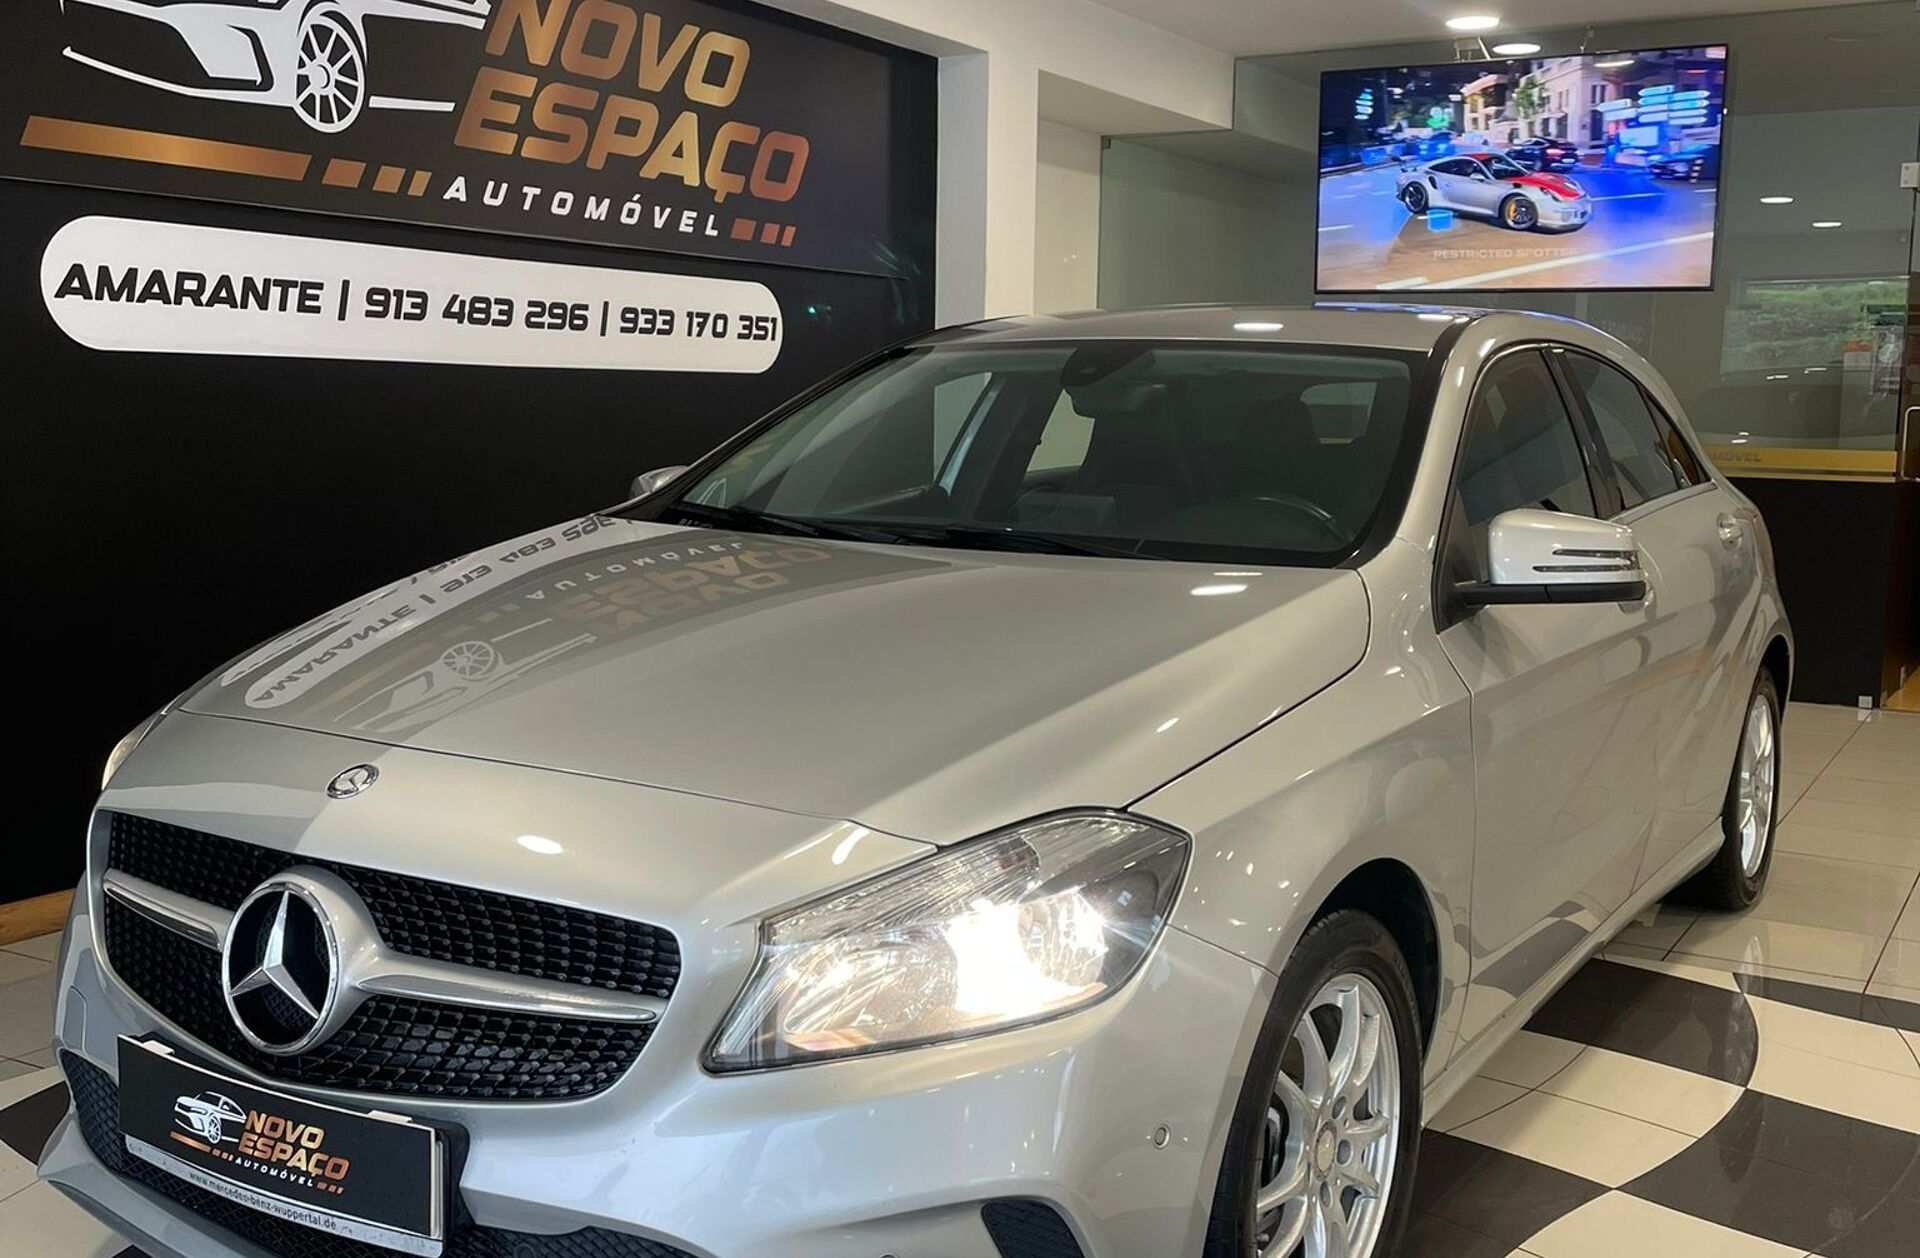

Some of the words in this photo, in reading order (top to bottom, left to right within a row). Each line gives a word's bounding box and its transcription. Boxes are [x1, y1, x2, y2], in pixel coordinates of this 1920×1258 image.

[485, 0, 751, 108] NOVO
[453, 66, 811, 204] ESPAÇO
[443, 175, 720, 237] AUTOMÓVEL
[1433, 249, 1513, 259] RESTRICTED
[54, 263, 324, 314] AMARANTE
[364, 287, 428, 322] 913
[442, 294, 515, 327] 483
[524, 299, 590, 332] 296
[619, 306, 676, 337] 933
[686, 311, 729, 339] 170
[737, 314, 778, 342] 351
[238, 1131, 350, 1181] ESPAÇO
[245, 1109, 325, 1150] NOVO
[188, 1170, 337, 1231] www.mercedes-benz-wuppertal.de
[235, 1156, 314, 1187] AUTOMÓVEL
